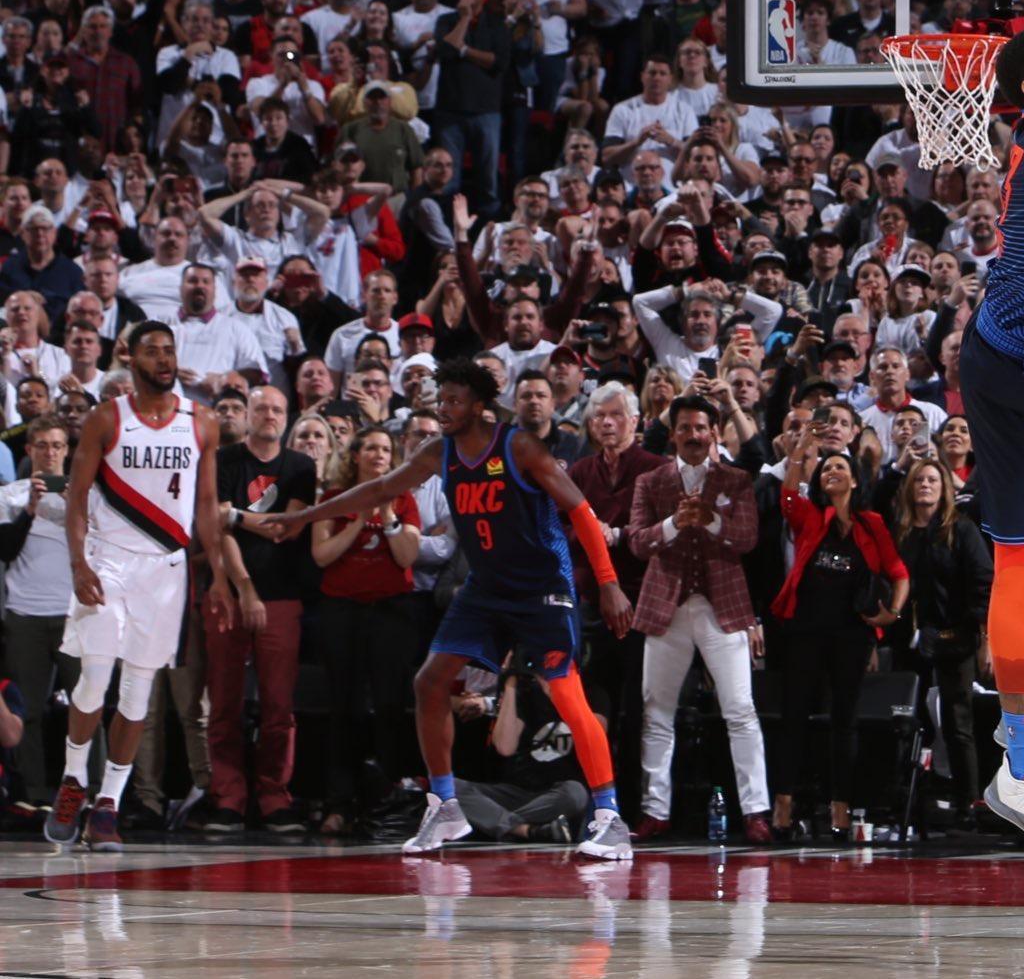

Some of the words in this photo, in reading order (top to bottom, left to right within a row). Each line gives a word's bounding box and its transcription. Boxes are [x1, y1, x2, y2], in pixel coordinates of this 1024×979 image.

[121, 445, 192, 469] BLAZERS
[167, 472, 181, 500] 4
[456, 480, 505, 515] OKC
[476, 519, 493, 551] 9
